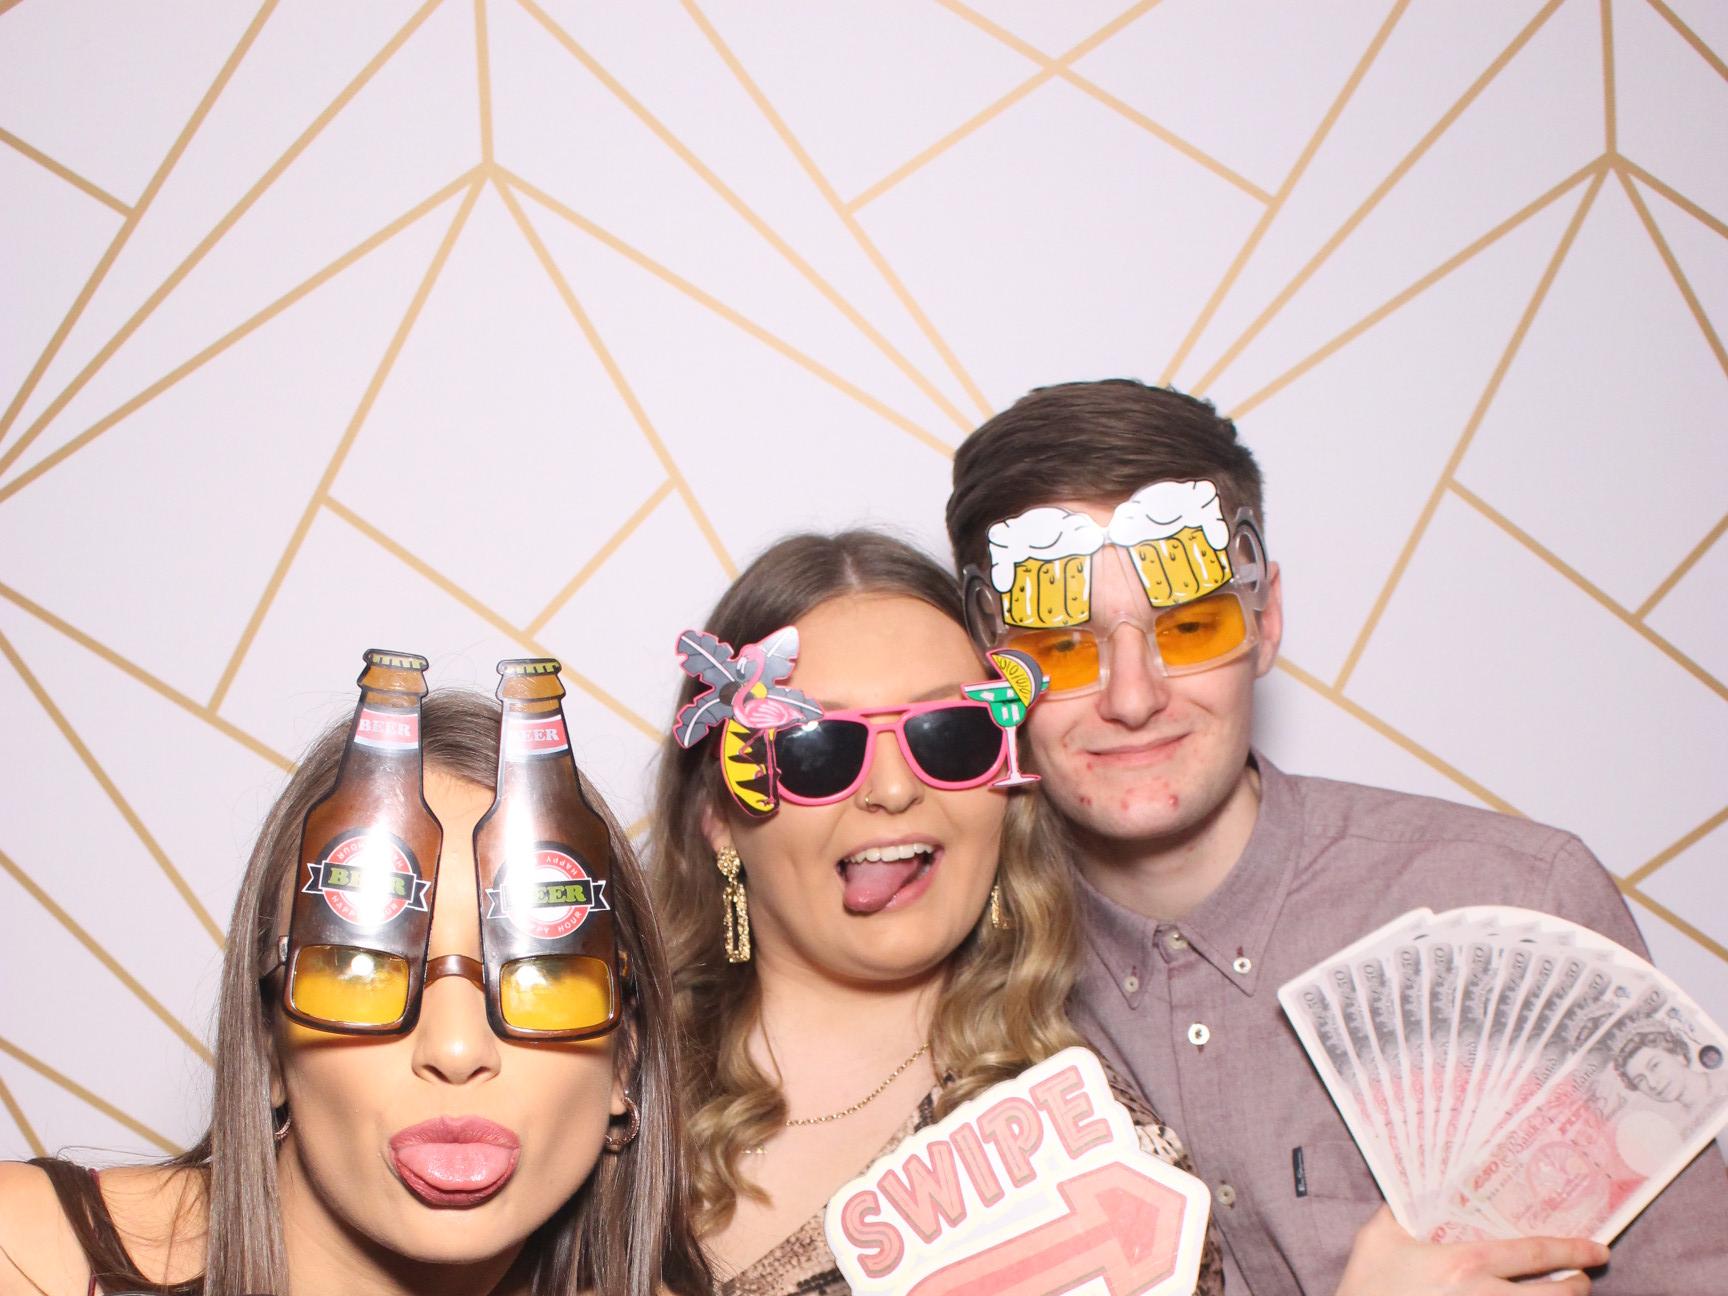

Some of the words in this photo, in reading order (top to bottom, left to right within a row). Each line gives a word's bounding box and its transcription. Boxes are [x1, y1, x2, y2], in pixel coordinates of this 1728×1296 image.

[359, 719, 412, 737] BEER
[511, 727, 560, 742] EER
[520, 884, 587, 904] EER
[558, 911, 583, 933] HOUR
[841, 1065, 1113, 1278] SWIPE
